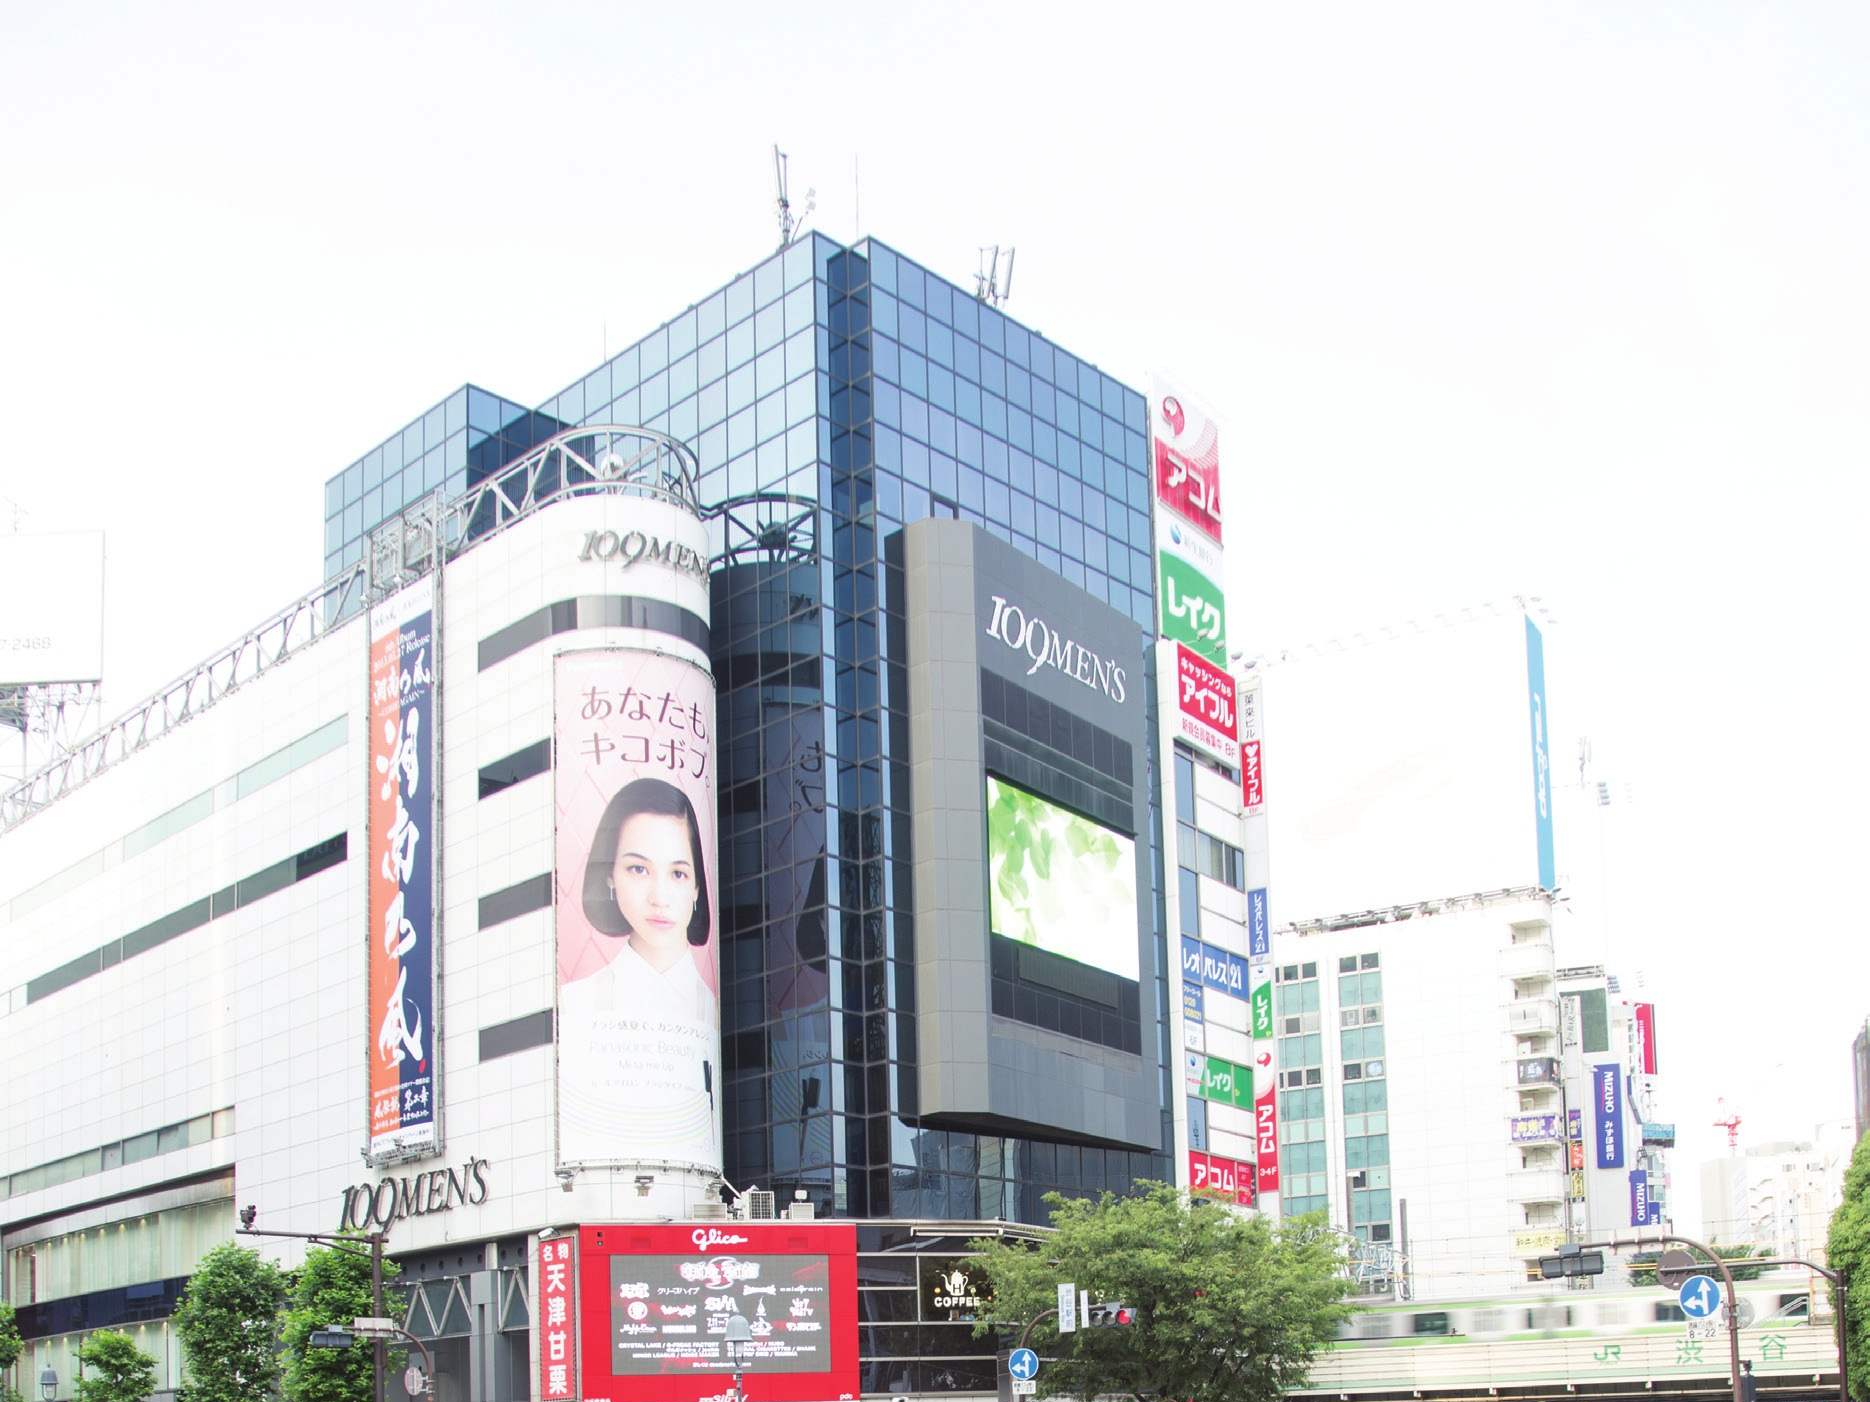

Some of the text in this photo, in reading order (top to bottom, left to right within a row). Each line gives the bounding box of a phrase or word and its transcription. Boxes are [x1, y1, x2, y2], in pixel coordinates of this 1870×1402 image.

[1167, 454, 1222, 524] アコム
[1167, 576, 1221, 639] レイク
[986, 595, 1126, 703] 109MEN'S
[1181, 674, 1234, 728] アイフル
[1246, 757, 1261, 805] アイフル
[1254, 893, 1265, 953] レオパレス21
[1183, 948, 1242, 990] レオパレス21
[1256, 995, 1269, 1030] レイク
[1206, 1069, 1233, 1092] レイク
[1604, 1071, 1615, 1113] MIZUHO
[1258, 1104, 1275, 1153] アコム
[337, 1155, 491, 1235] 109MEN'S
[1193, 1163, 1235, 1191] アコム
[1635, 1182, 1646, 1222] MIZUHO
[543, 1243, 569, 1262] 名物
[691, 1229, 748, 1251] Glico
[934, 1296, 981, 1308] COFFEE
[546, 1263, 568, 1395] 天津甘栗
[1594, 1344, 1621, 1361] JR
